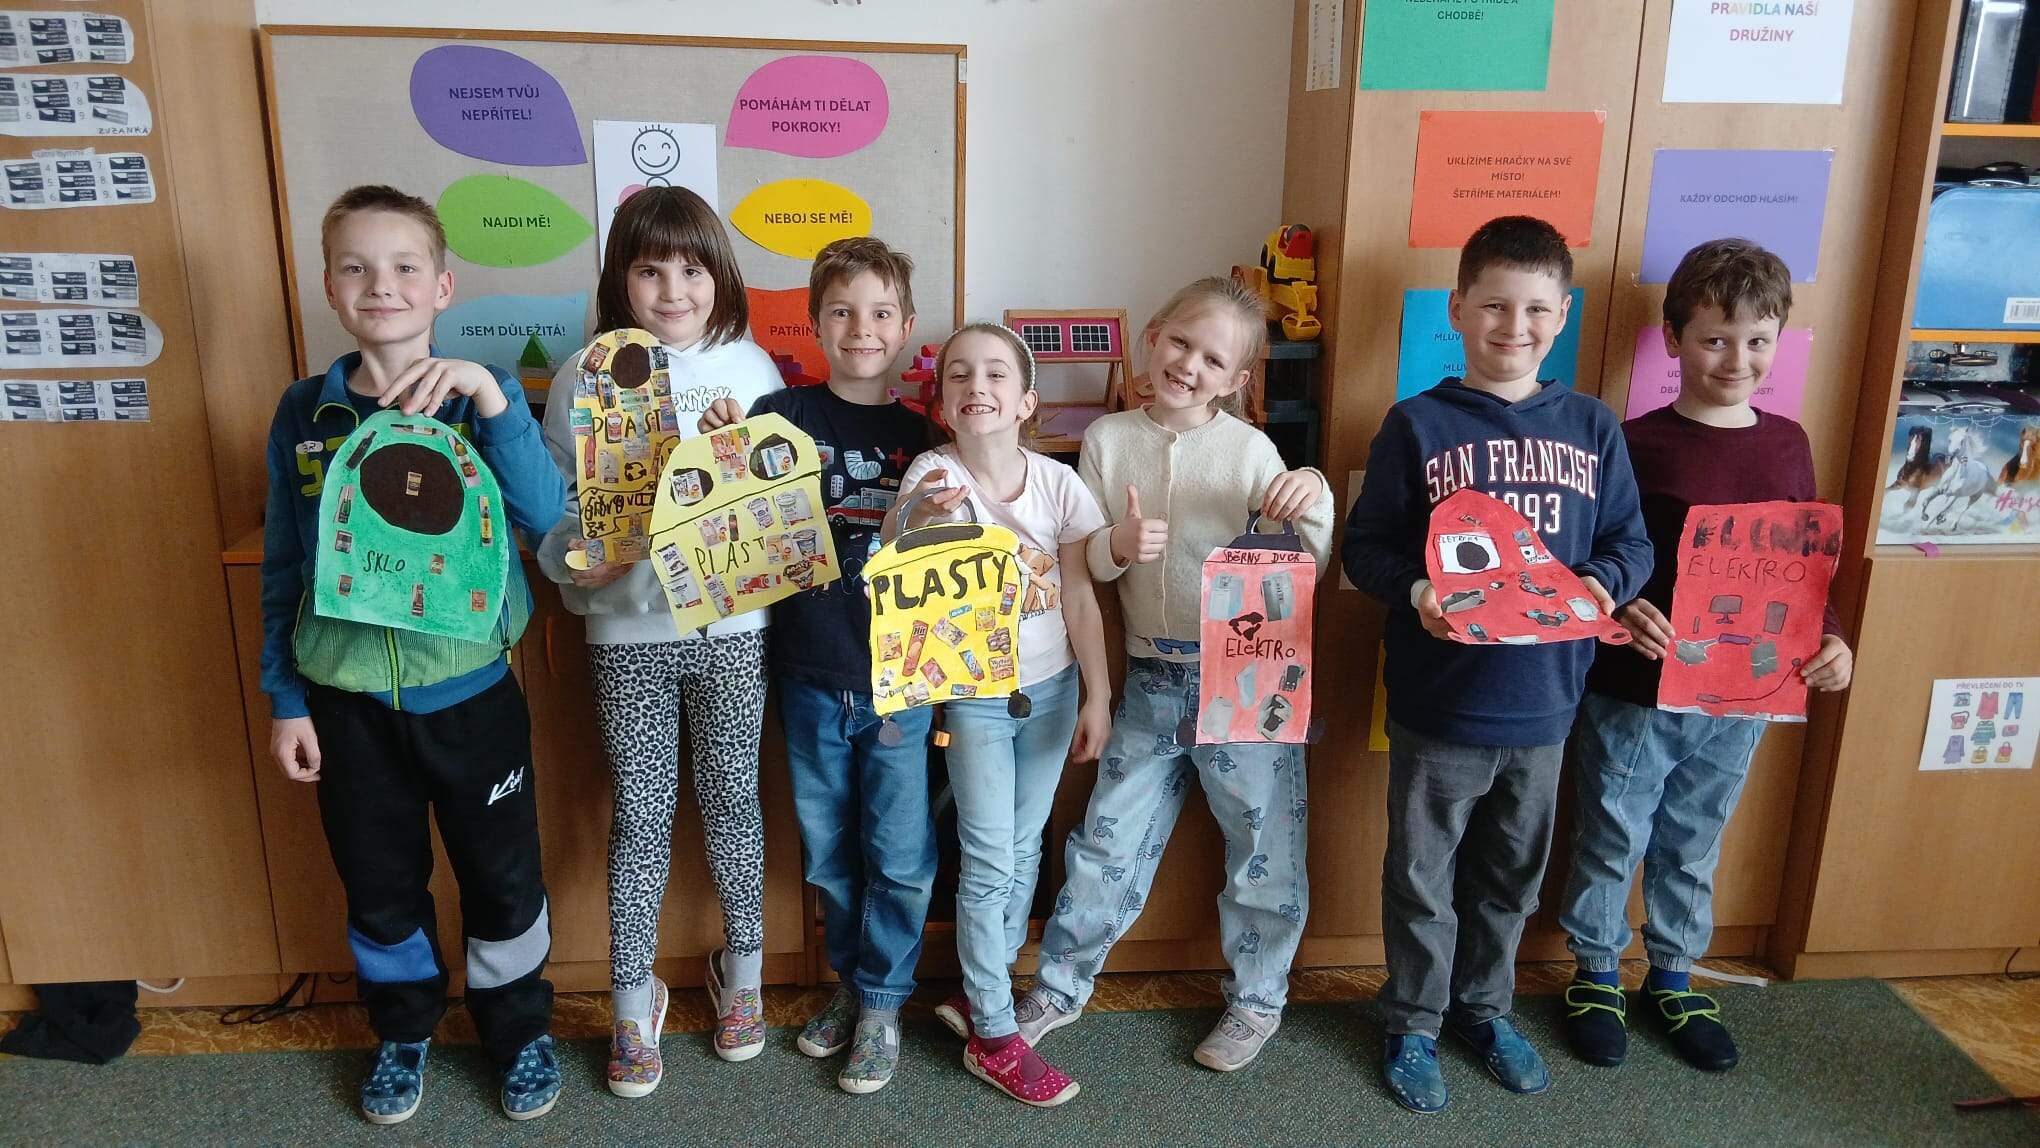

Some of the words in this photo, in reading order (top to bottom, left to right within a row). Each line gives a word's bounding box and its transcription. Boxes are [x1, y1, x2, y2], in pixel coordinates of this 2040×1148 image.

[1711, 3, 1781, 16] PRAVIDLA
[1729, 26, 1794, 42] DRUŽINY
[449, 87, 503, 99] NEJSEM
[507, 84, 539, 99] TVŮJ
[739, 97, 809, 111] POMÁHÁM
[814, 100, 827, 111] TI
[462, 108, 532, 121] NEPŘÍTEL!
[771, 120, 840, 134] POKROKY!
[1537, 156, 1551, 166] NA
[1491, 171, 1525, 181] MÍSTO!
[1714, 193, 1757, 203] ODCHOD
[482, 217, 523, 228] NAJDI
[526, 214, 551, 228] MĚ!
[764, 213, 807, 225] NEBOJ
[810, 213, 826, 224] SE
[830, 210, 853, 224] MĚ!
[461, 326, 495, 337] JSEM
[498, 323, 566, 336] DŮLEŽITÁ!
[1434, 333, 1462, 341] MLUV
[1426, 443, 1474, 504] SAN
[363, 550, 406, 573] SKLO
[695, 536, 765, 577] PLAST
[1688, 555, 1807, 585] ELEKTRO
[872, 552, 1008, 615] PLASTY
